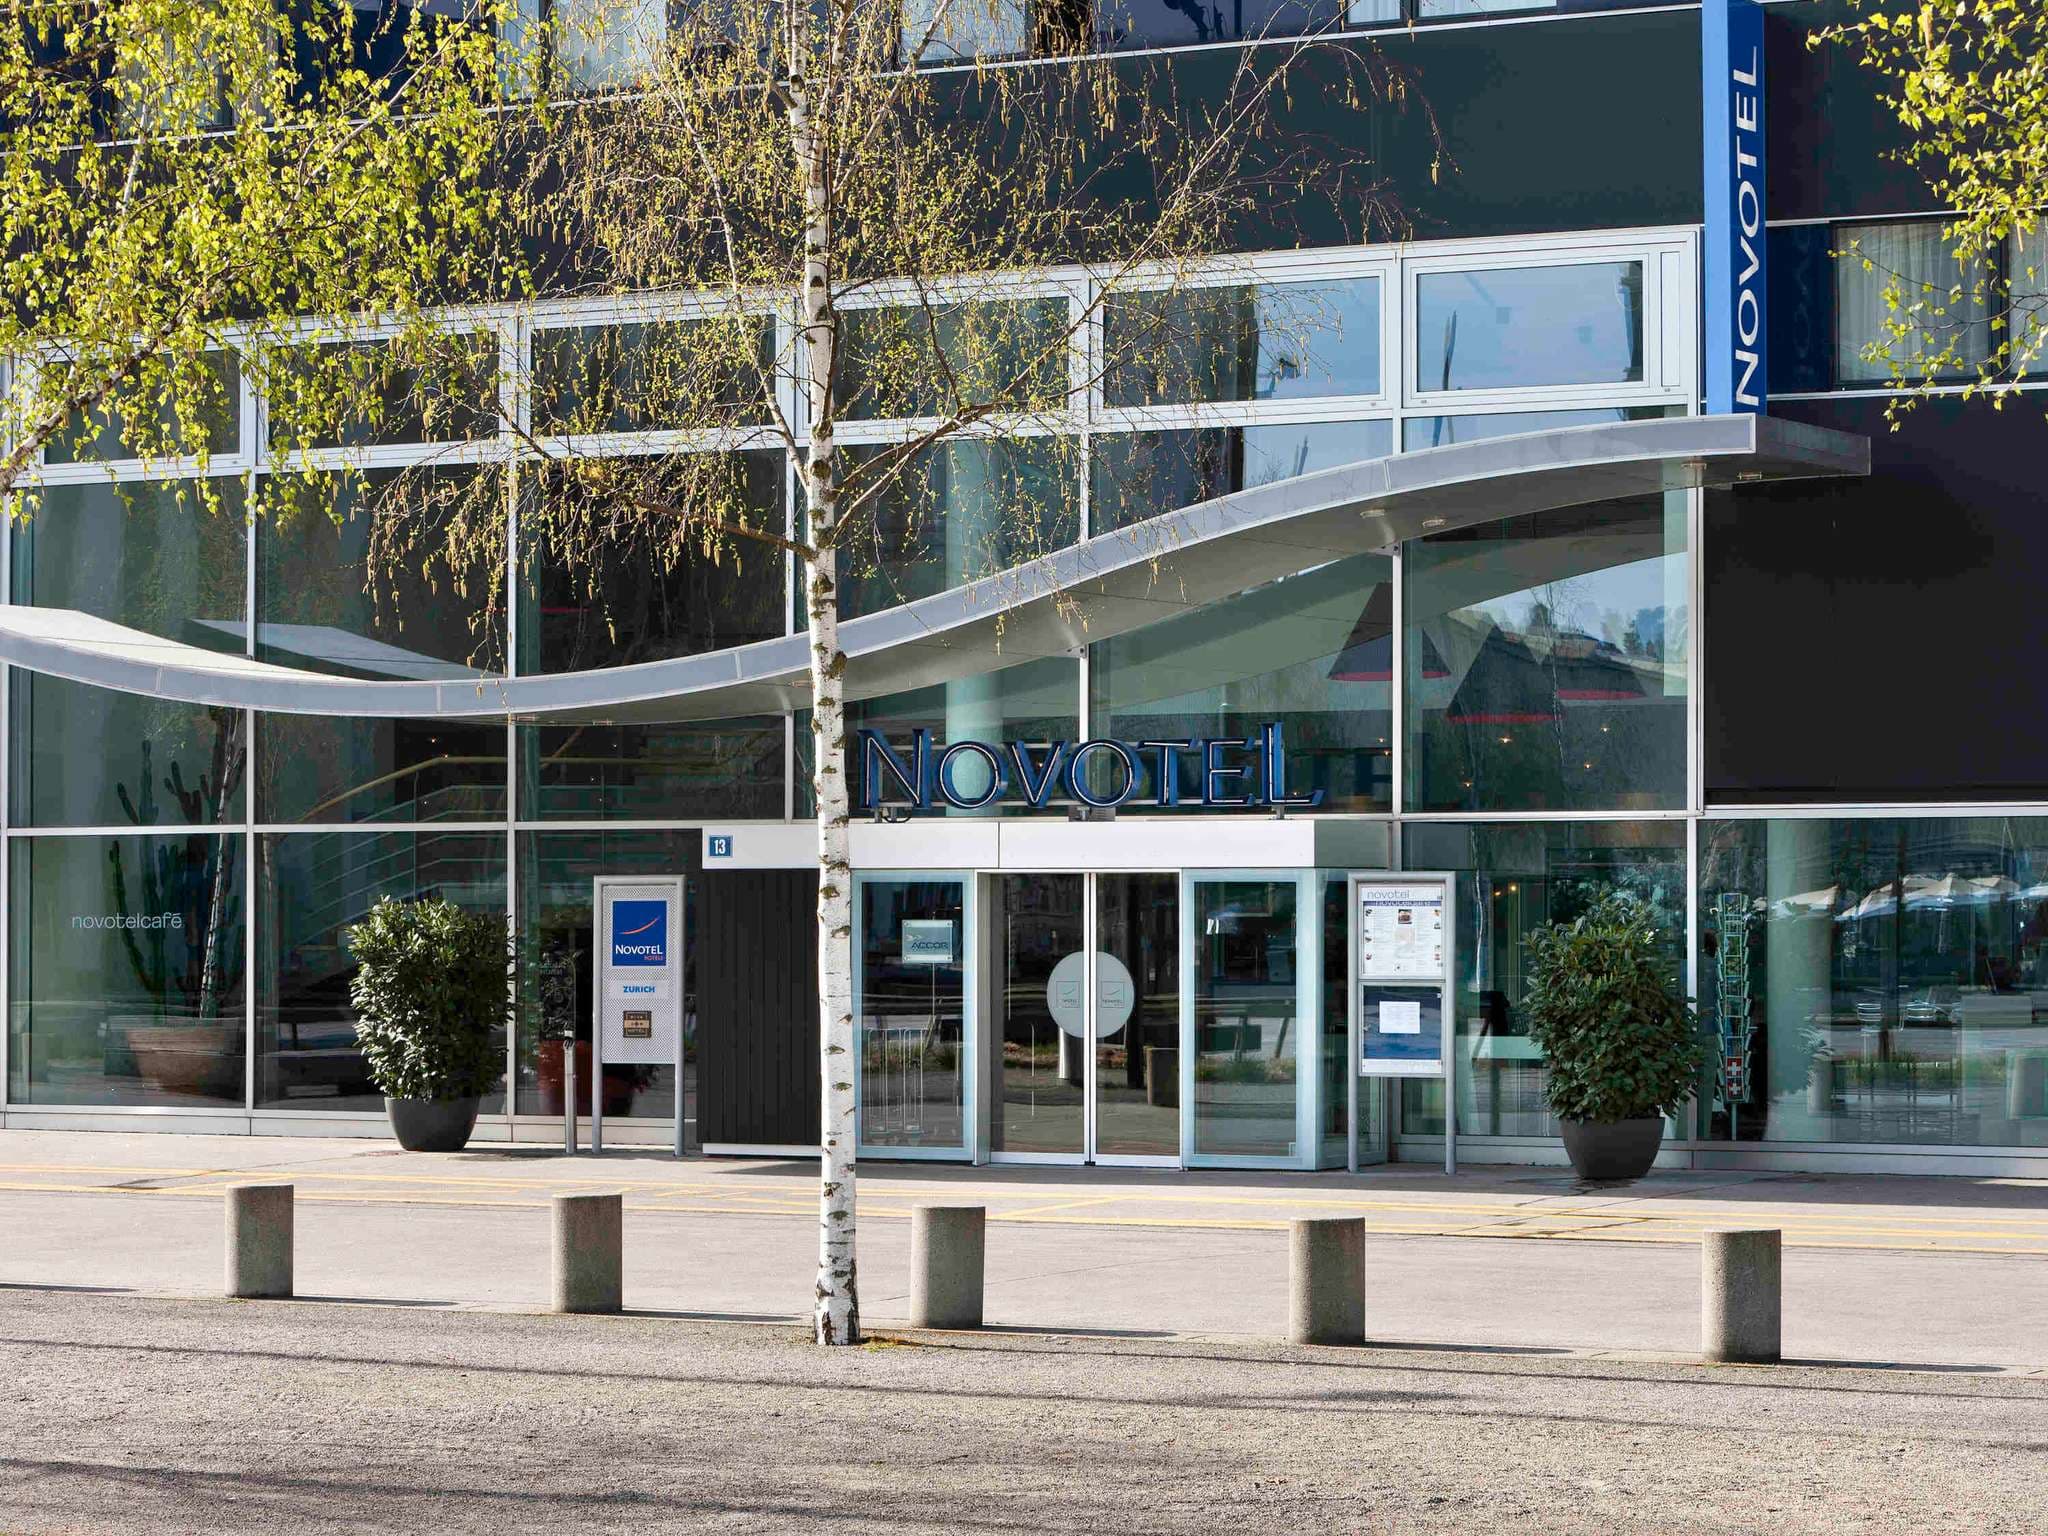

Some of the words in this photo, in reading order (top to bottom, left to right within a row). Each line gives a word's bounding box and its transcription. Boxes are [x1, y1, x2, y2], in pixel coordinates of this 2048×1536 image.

[1733, 46, 1760, 406] NOVOTEL
[857, 721, 1326, 809] NOVOTEL
[713, 838, 726, 855] 13
[71, 912, 182, 929] novotelcafé
[615, 944, 663, 955] NOVOTEL
[623, 985, 656, 993] ZURICH
